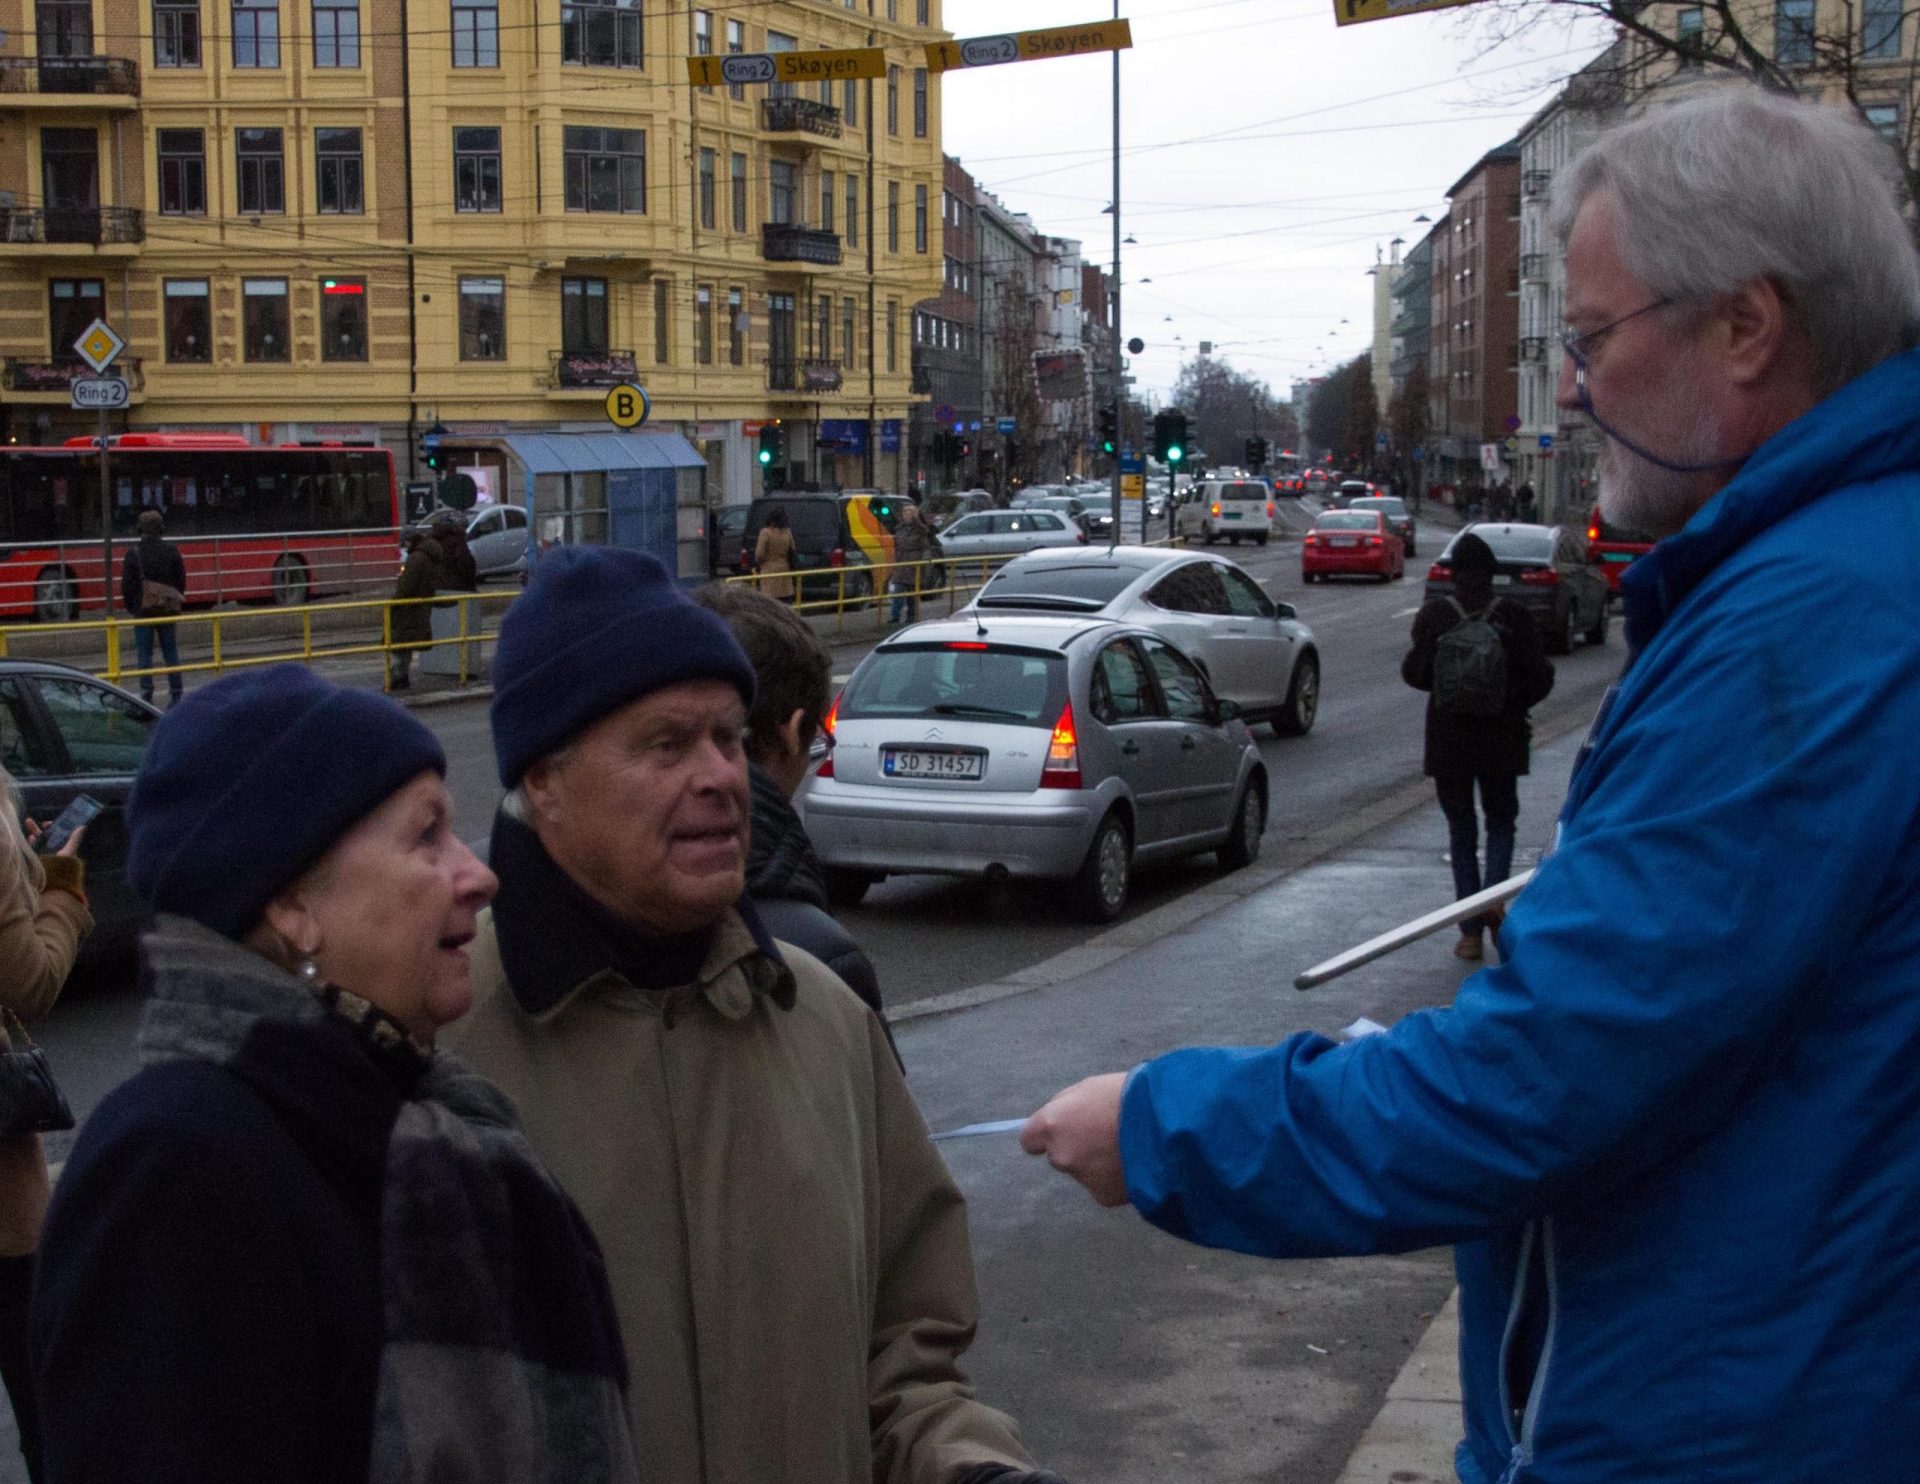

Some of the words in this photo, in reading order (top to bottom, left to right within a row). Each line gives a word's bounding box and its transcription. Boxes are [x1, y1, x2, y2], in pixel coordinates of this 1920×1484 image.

[967, 45, 999, 61] Ring
[1003, 43, 1012, 57] 2
[1027, 31, 1104, 54] Skøyen
[728, 63, 757, 78] Ring
[760, 63, 770, 75] 2
[785, 57, 858, 77] Skøyen
[79, 384, 109, 401] Ring
[111, 384, 121, 400] 2
[617, 393, 634, 418] B
[900, 754, 920, 771] SD
[927, 754, 976, 773] 31457
